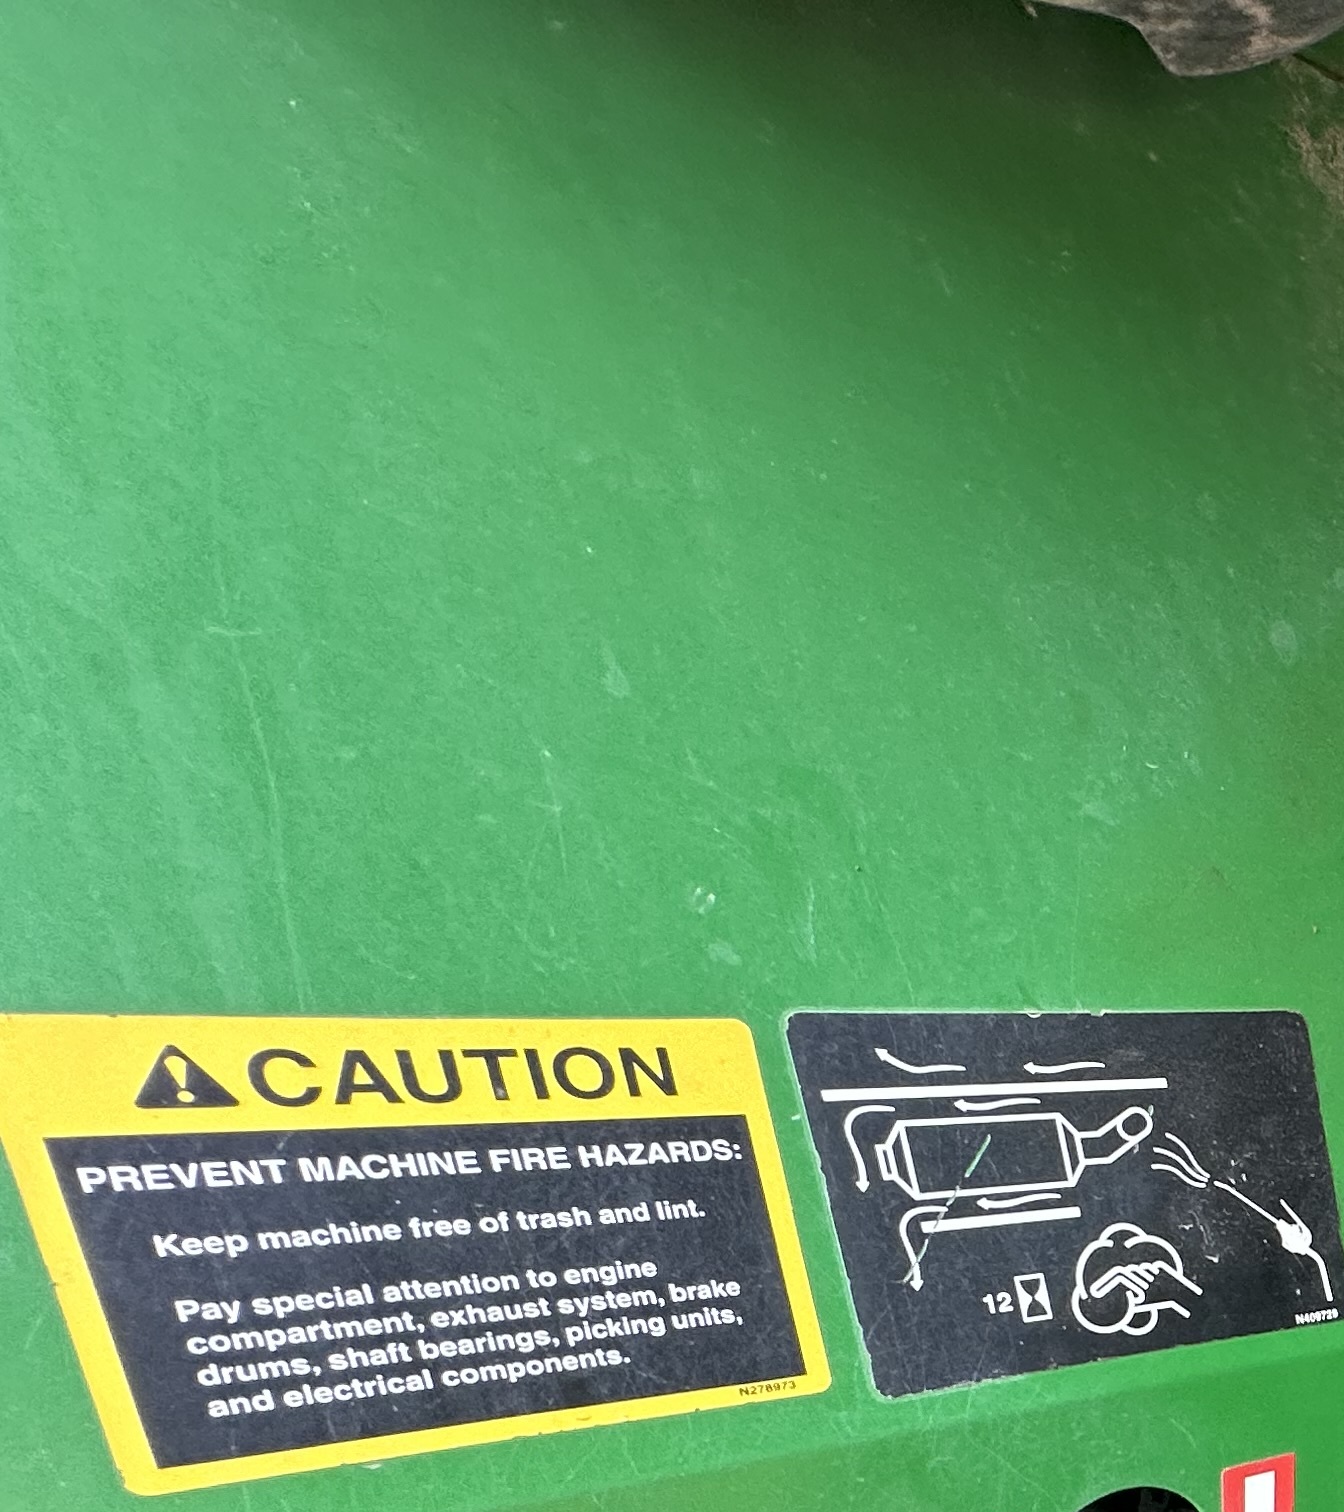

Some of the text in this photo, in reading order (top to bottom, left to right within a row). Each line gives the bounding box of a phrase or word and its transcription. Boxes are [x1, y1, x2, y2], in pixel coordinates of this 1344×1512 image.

[247, 1046, 679, 1107] CAUTION
[76, 1138, 743, 1194] PREVENT MACHINE FIRE HAZARDS:
[153, 1198, 706, 1259] Keep machine free of trash and lint.
[174, 1260, 658, 1324] Pay special attention to engine
[186, 1279, 741, 1355] compartment, exhaust system, brake
[982, 1291, 1014, 1314] 12
[196, 1307, 744, 1387] drums, shaft bearings, picking units,
[207, 1348, 632, 1418] and electrical components.
[739, 1380, 797, 1396] N278973
